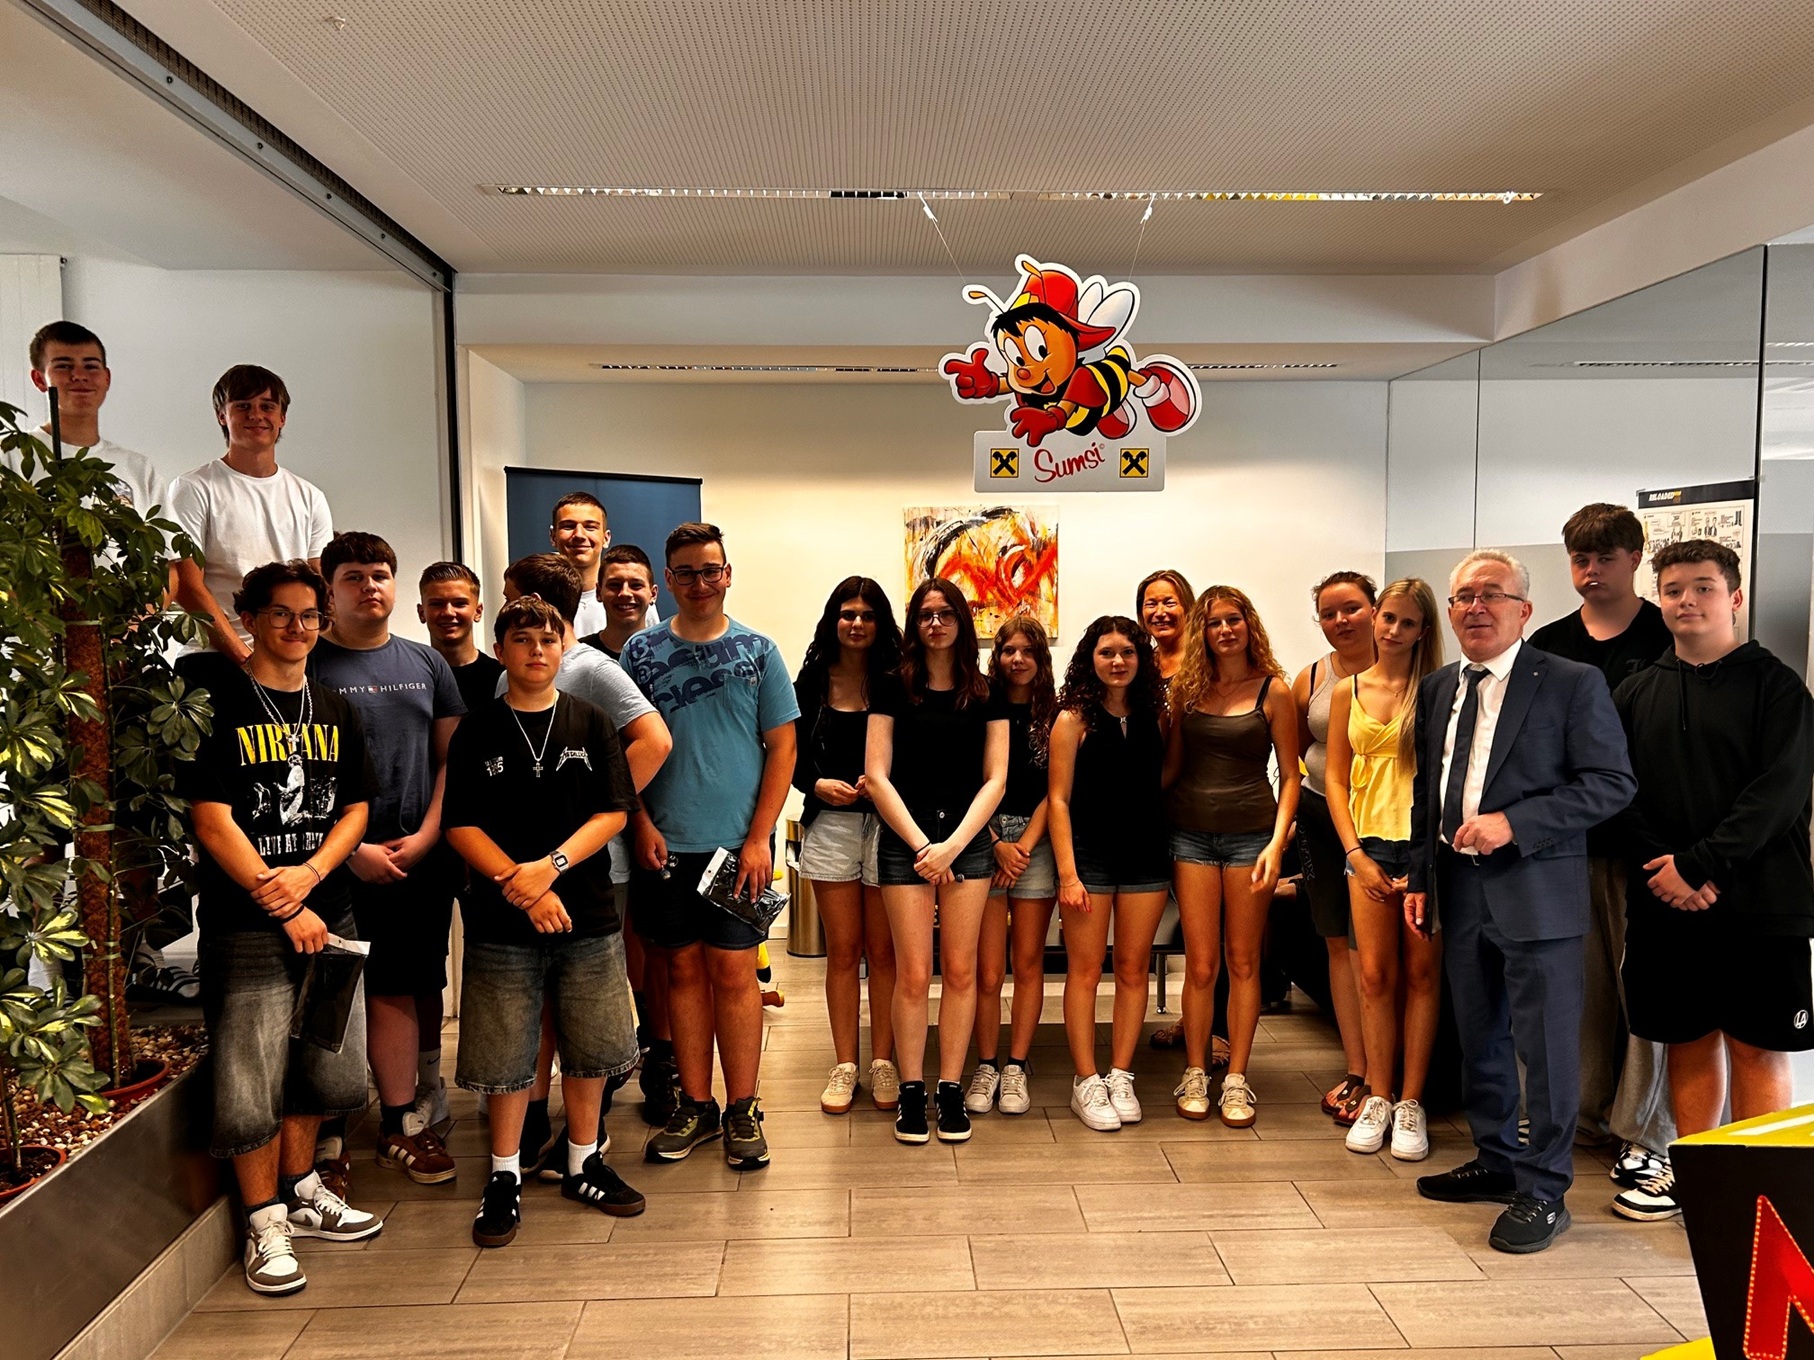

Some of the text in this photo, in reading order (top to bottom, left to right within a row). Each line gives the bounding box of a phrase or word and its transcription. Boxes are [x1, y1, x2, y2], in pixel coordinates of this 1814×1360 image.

[1034, 441, 1106, 483] Sumsi
[333, 682, 427, 695] MMY HILFIGER
[235, 722, 339, 767] NIRVANA
